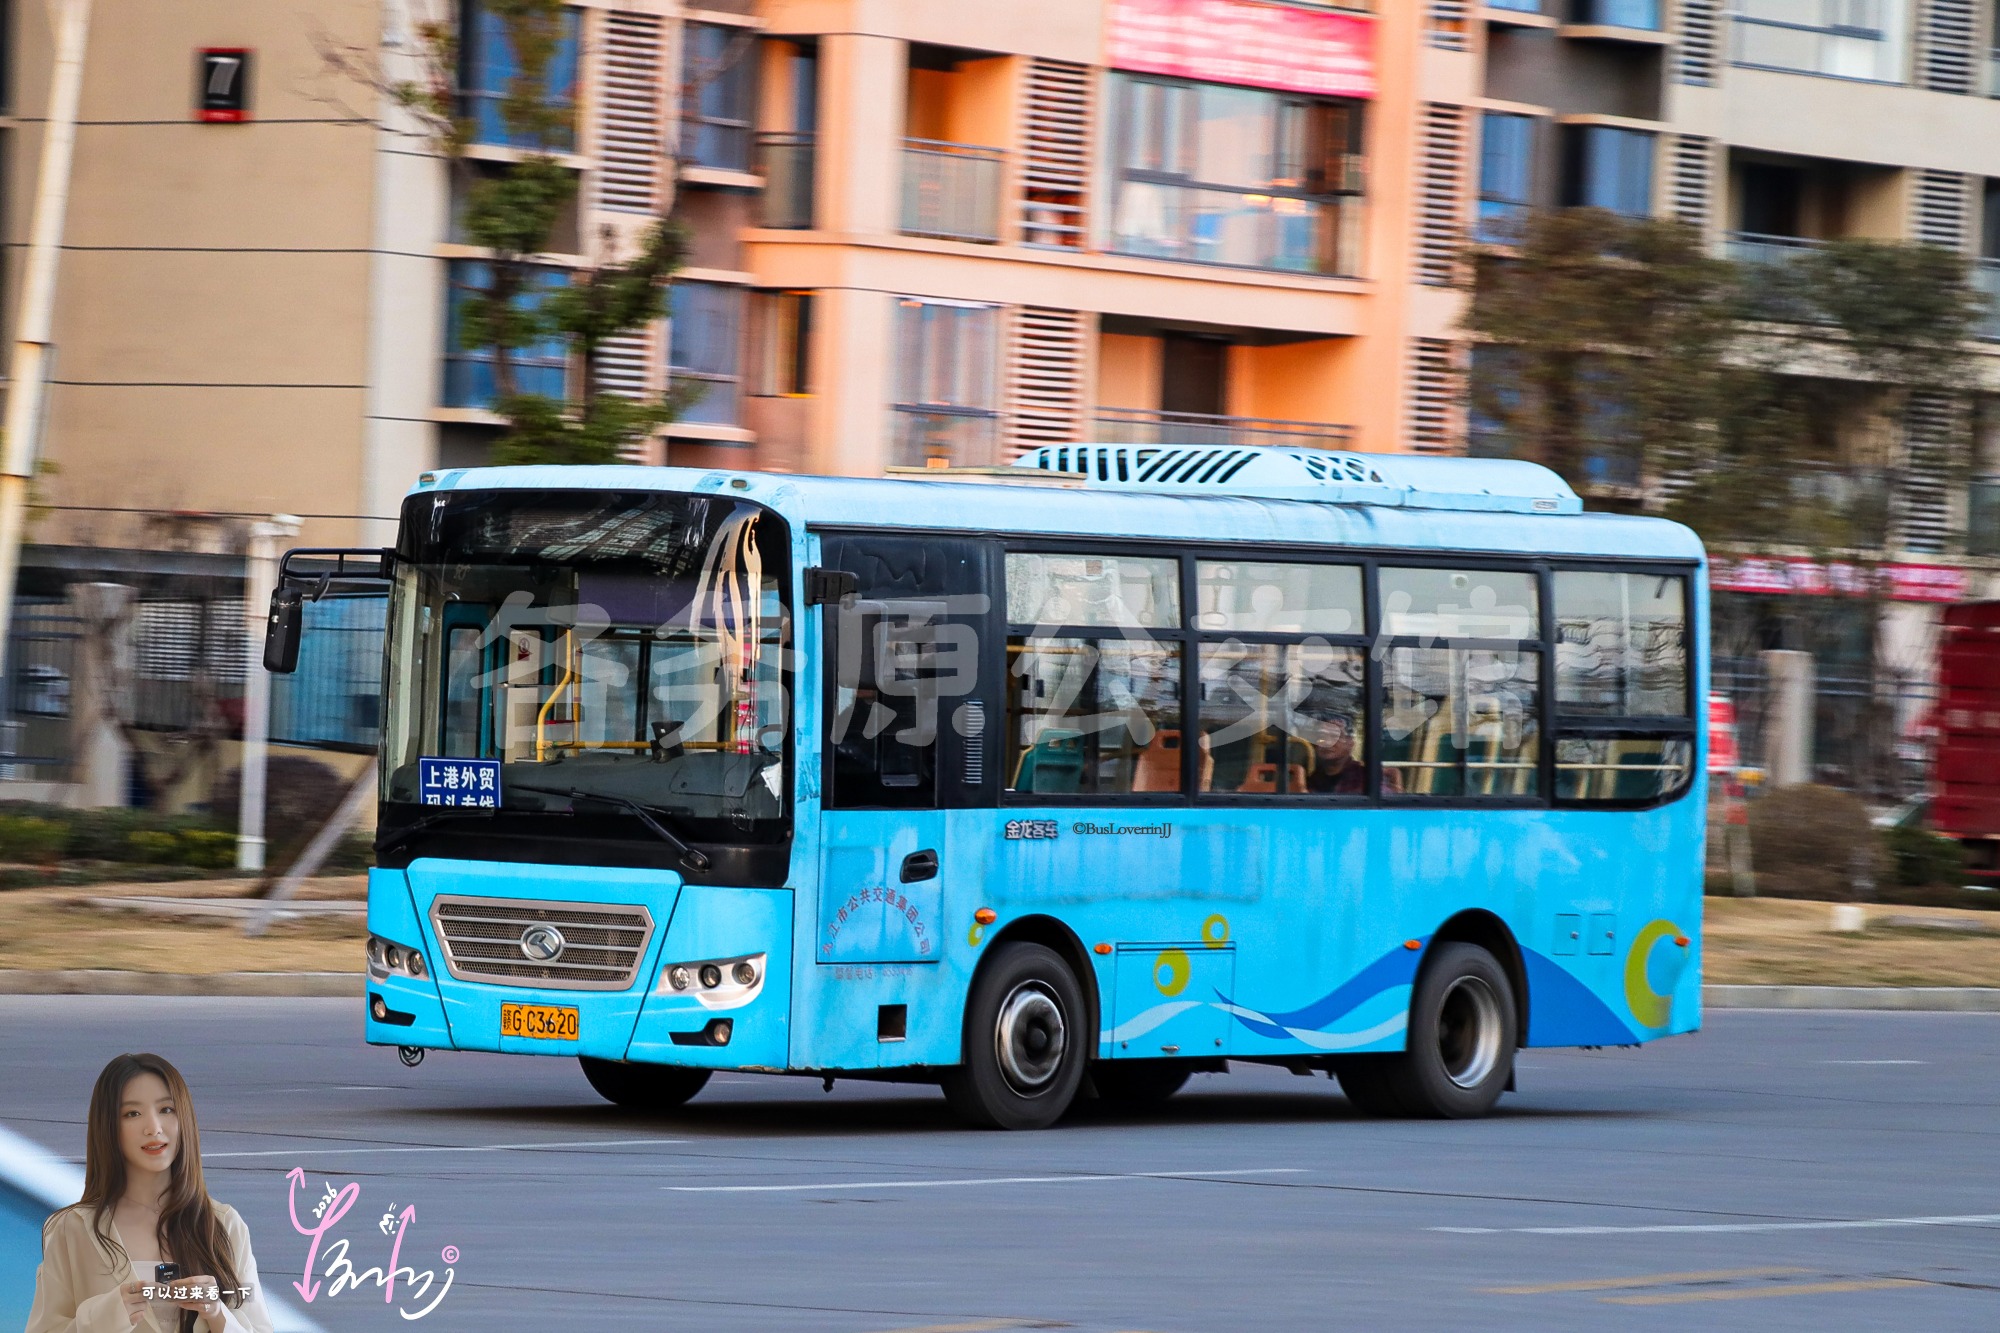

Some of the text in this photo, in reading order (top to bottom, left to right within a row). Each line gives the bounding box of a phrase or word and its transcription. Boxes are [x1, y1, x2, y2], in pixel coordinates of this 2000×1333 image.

[425, 765, 495, 791] 上港外贸
[1005, 819, 1059, 839] 金龙客车
